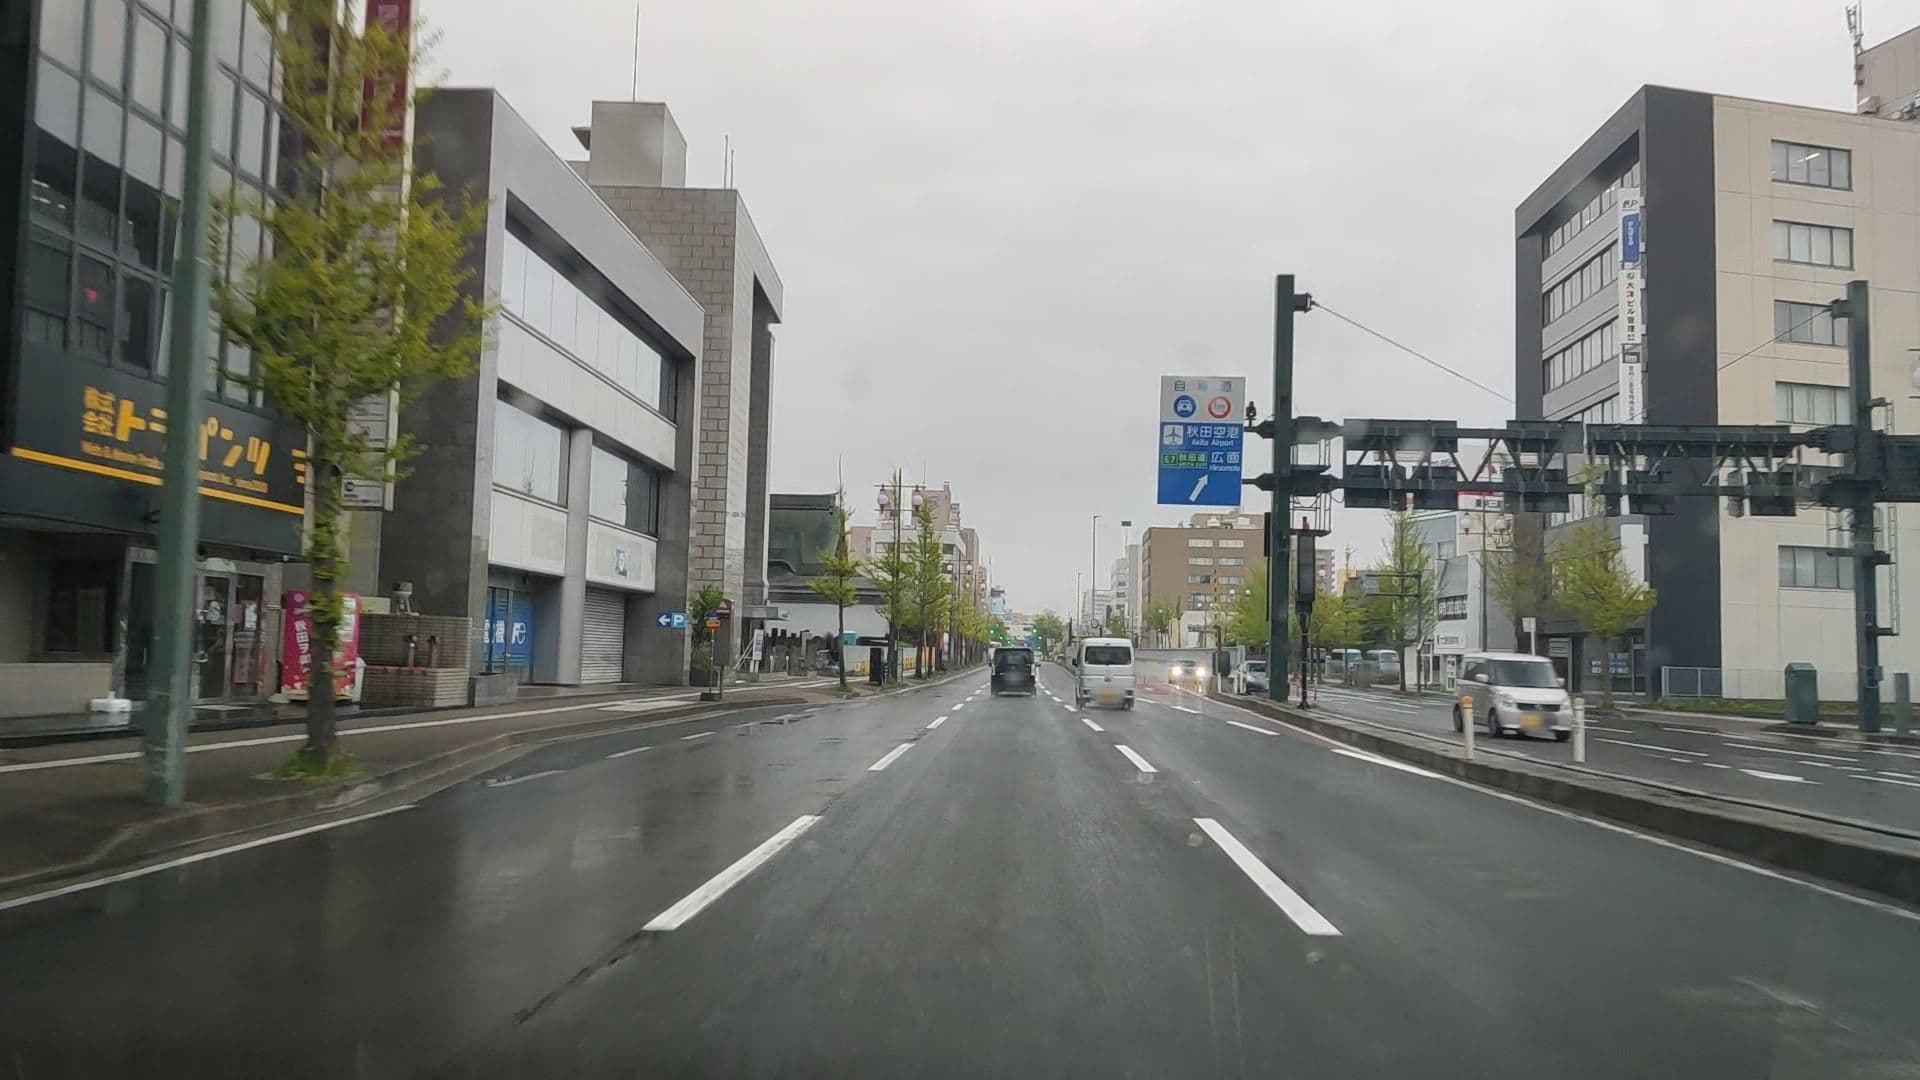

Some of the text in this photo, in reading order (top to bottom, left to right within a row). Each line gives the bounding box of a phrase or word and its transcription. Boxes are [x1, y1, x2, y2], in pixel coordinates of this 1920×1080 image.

[1187, 426, 1239, 439] 秋田空港
[1211, 439, 1234, 447] Airport
[1211, 452, 1240, 464] 広面
[673, 614, 684, 624] P
